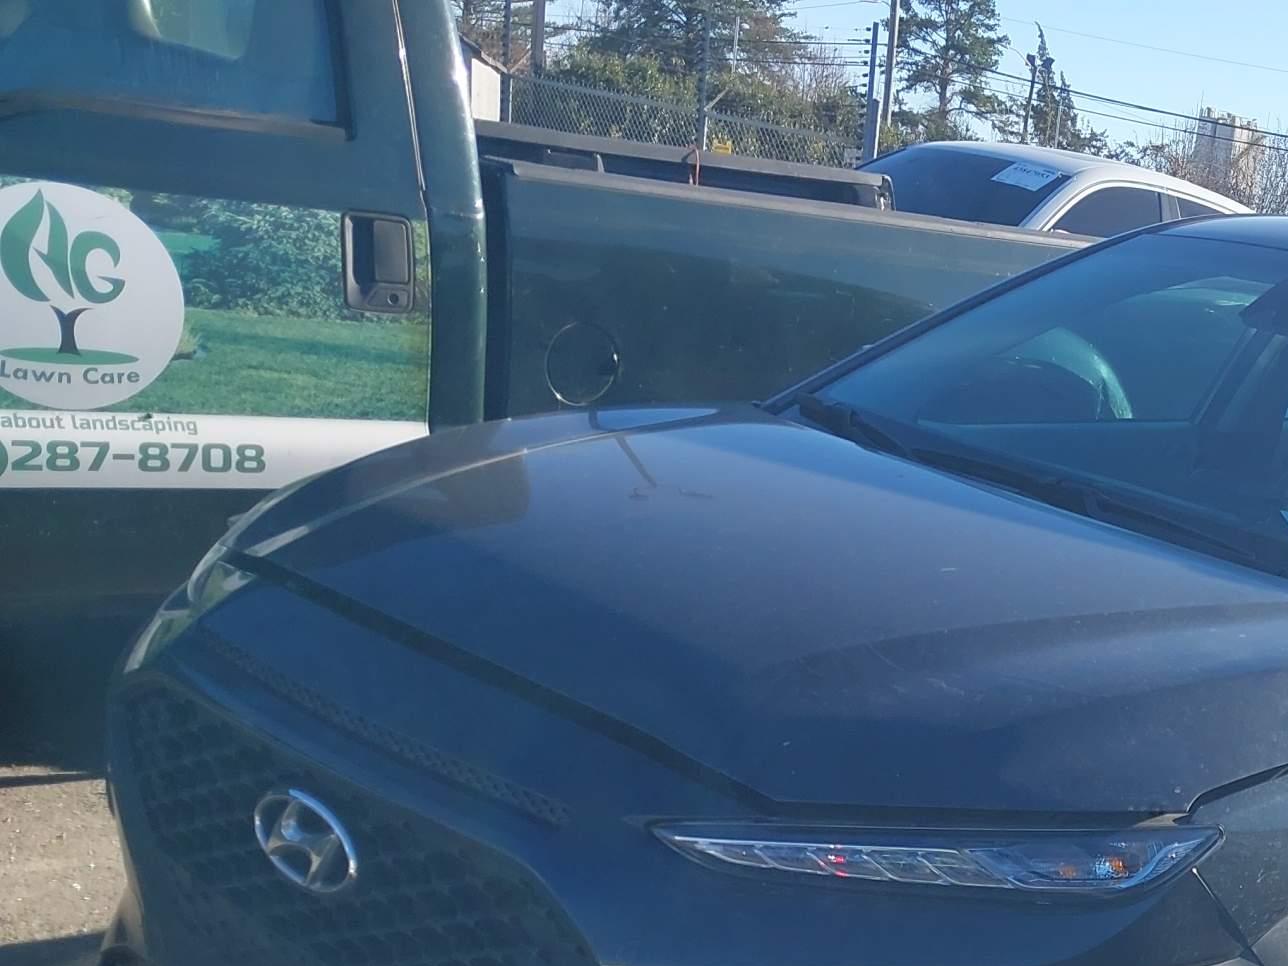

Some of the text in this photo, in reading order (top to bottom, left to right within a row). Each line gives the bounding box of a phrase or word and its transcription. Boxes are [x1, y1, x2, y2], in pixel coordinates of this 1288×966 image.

[0, 360, 141, 385] Lawn Care
[0, 413, 199, 435] about landscaping
